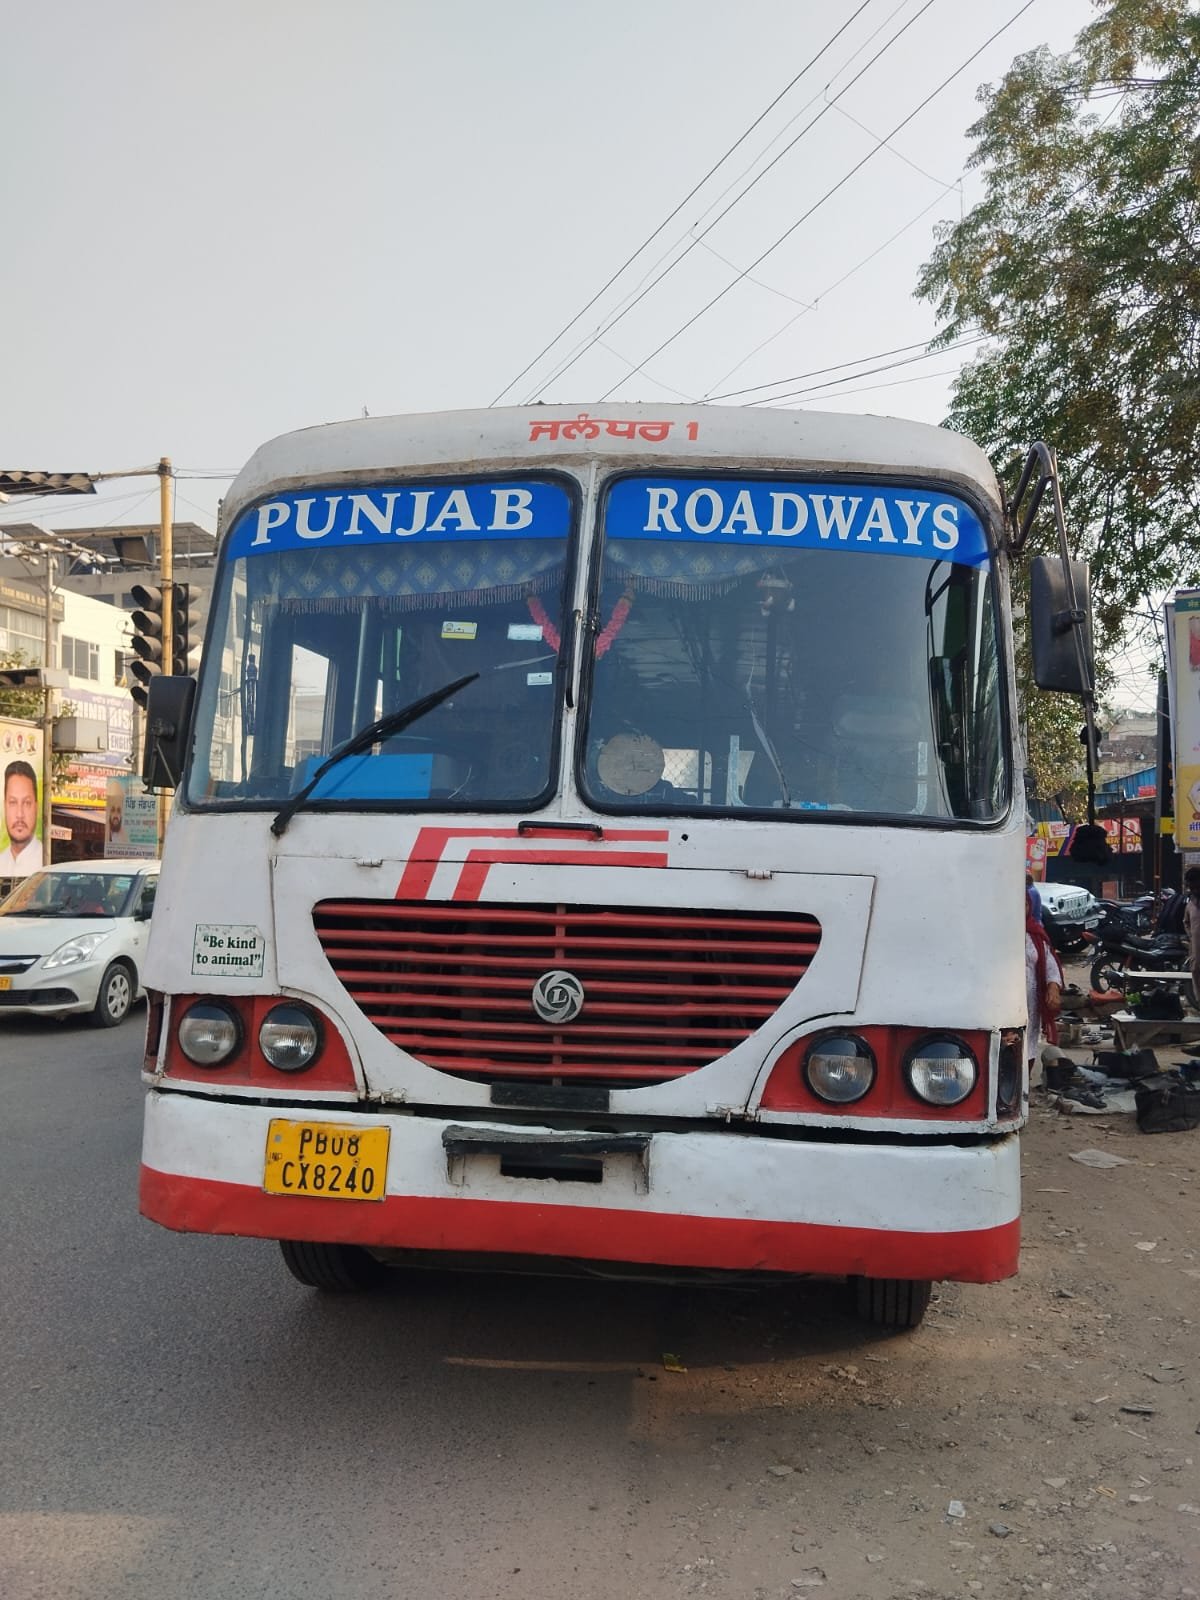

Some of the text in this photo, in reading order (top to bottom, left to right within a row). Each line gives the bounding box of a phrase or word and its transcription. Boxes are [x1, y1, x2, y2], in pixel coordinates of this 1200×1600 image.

[686, 422, 699, 441] 1
[251, 488, 534, 547] PUNJAB
[643, 487, 960, 551] ROADWAYS
[227, 936, 257, 949] kind
[196, 953, 209, 964] to
[298, 1128, 360, 1157] PB08
[282, 1161, 375, 1194] CX8240
